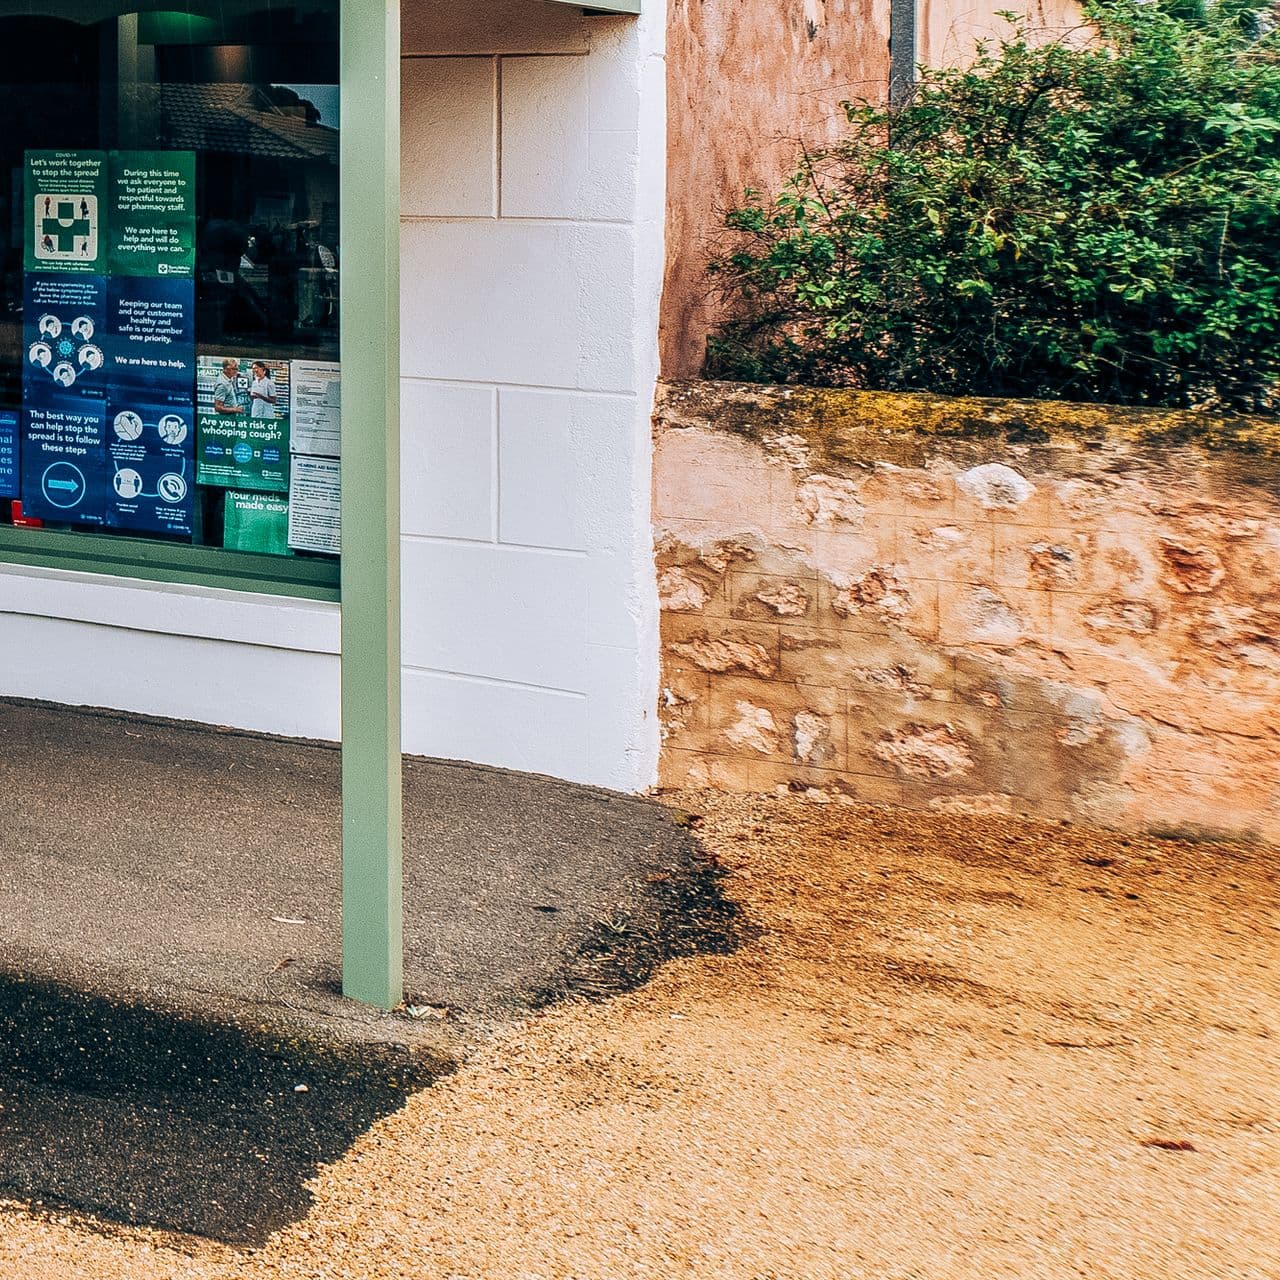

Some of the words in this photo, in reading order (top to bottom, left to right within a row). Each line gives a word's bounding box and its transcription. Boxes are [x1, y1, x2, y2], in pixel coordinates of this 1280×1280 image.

[69, 160, 101, 168] together
[42, 169, 58, 177] stop
[74, 169, 99, 177] spread
[124, 169, 147, 178] During
[137, 186, 162, 194] patient
[119, 194, 154, 202] respectful
[131, 203, 166, 212] pharmacy
[124, 235, 139, 243] help
[118, 244, 155, 253] everything
[119, 299, 149, 309] Keeping
[147, 310, 183, 318] customers
[130, 317, 156, 326] healthy
[158, 318, 171, 326] and
[115, 356, 127, 364] We
[30, 410, 44, 419] The
[46, 411, 64, 420] best
[65, 415, 81, 423] way
[84, 416, 99, 424] you
[201, 417, 217, 425] Are
[220, 420, 236, 428] you
[250, 421, 265, 430] risk
[268, 422, 277, 430] of
[202, 426, 247, 439] whooping
[249, 431, 282, 440] cough?
[229, 491, 250, 500] Your
[253, 492, 280, 502] meds
[236, 501, 263, 510] made
[266, 504, 289, 514] easy
